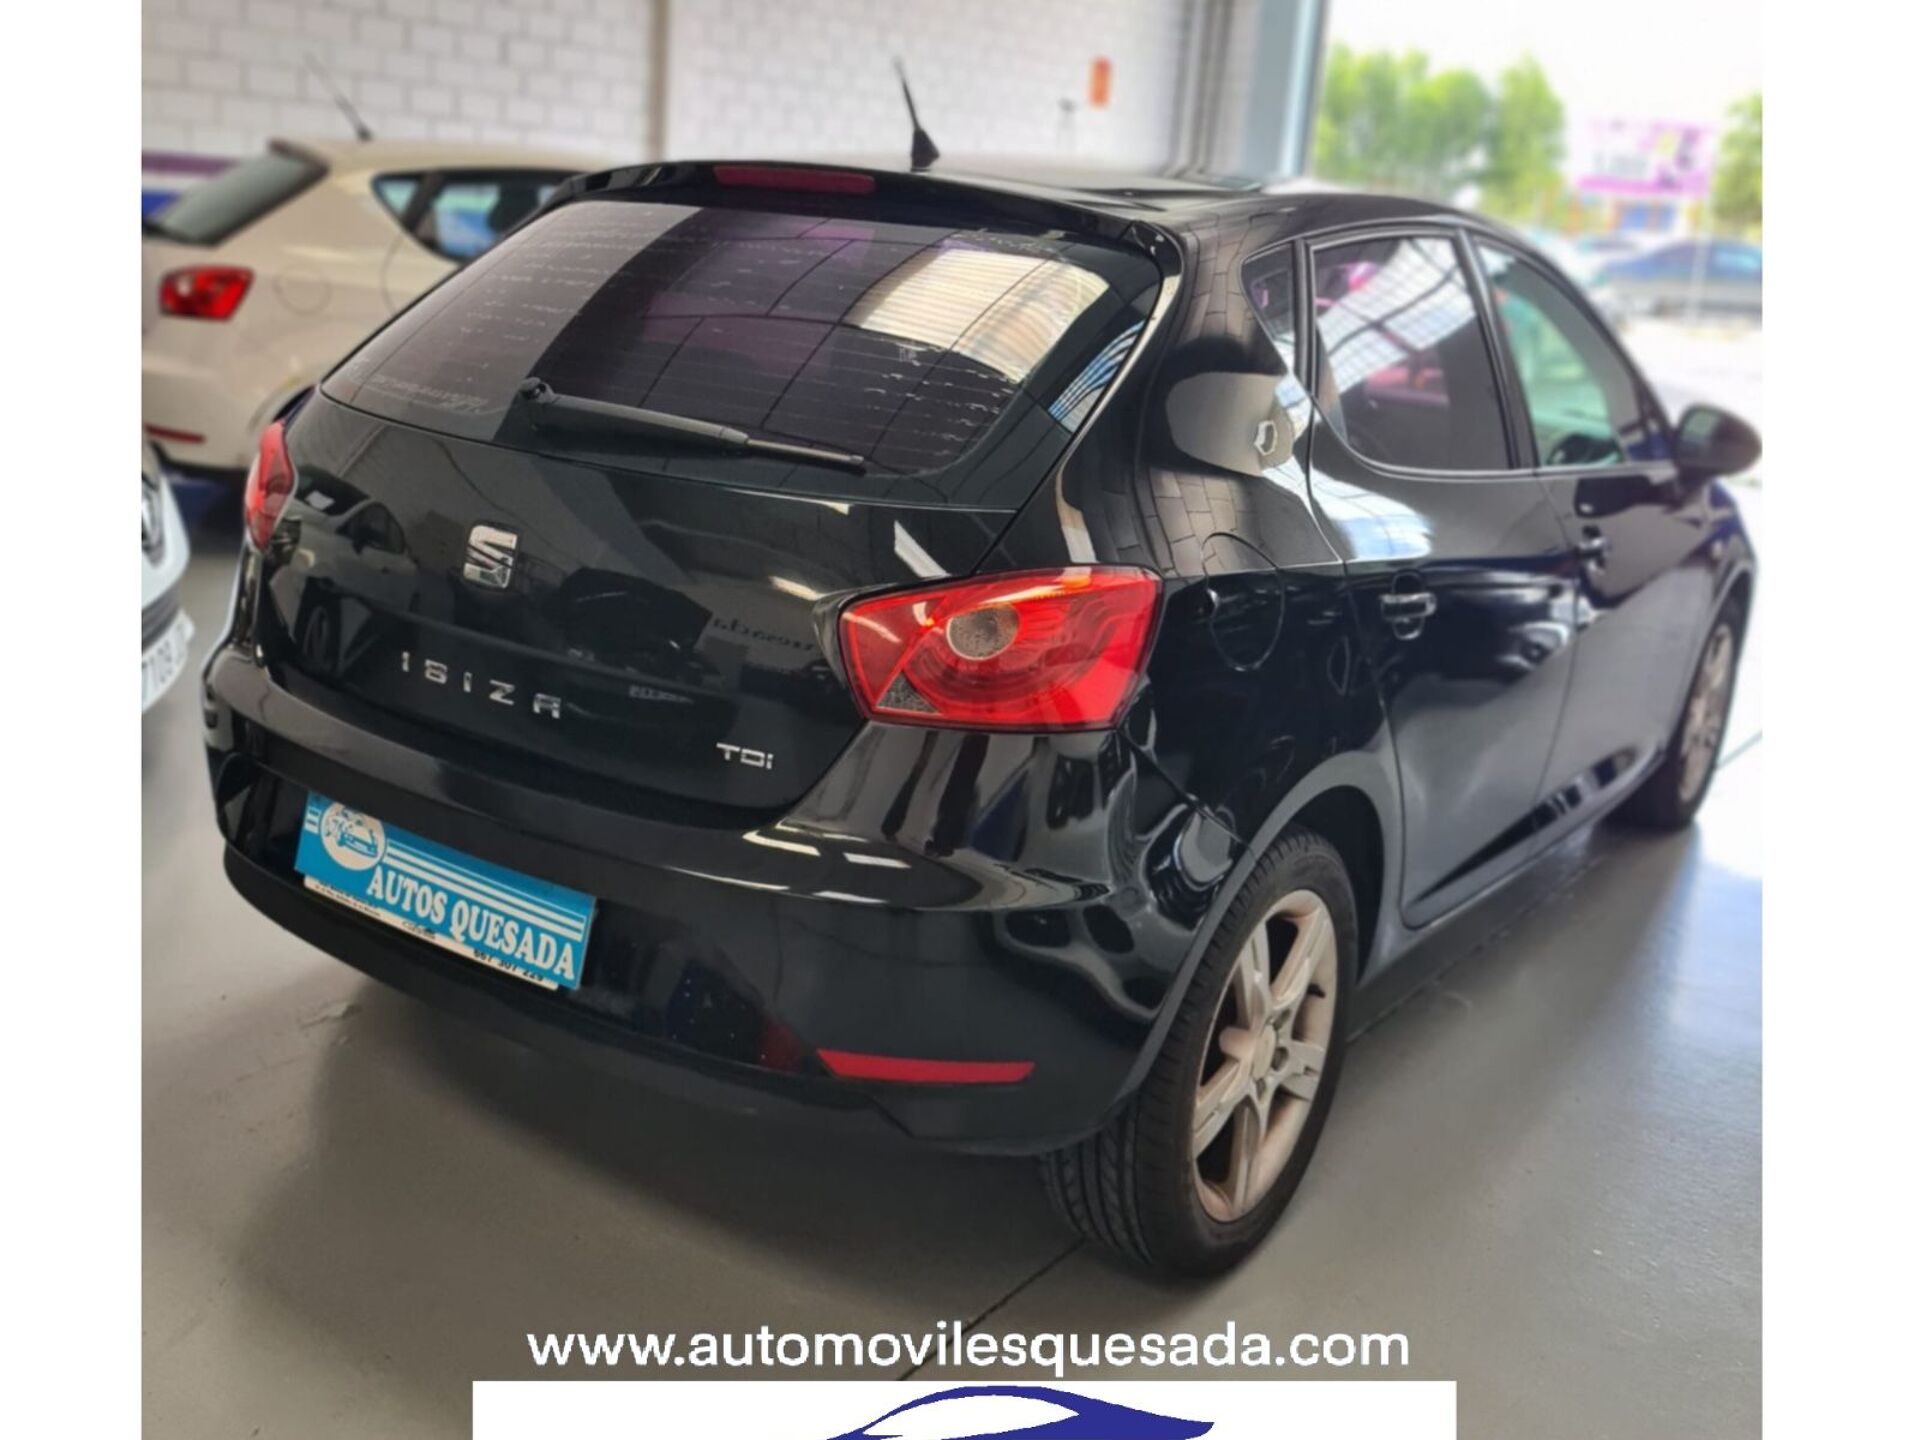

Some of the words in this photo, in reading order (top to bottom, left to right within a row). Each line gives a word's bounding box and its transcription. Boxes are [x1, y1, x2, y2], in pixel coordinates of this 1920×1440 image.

[402, 651, 561, 719] IBIZA
[366, 865, 448, 924] AUTOS
[450, 899, 575, 980] QUESADA
